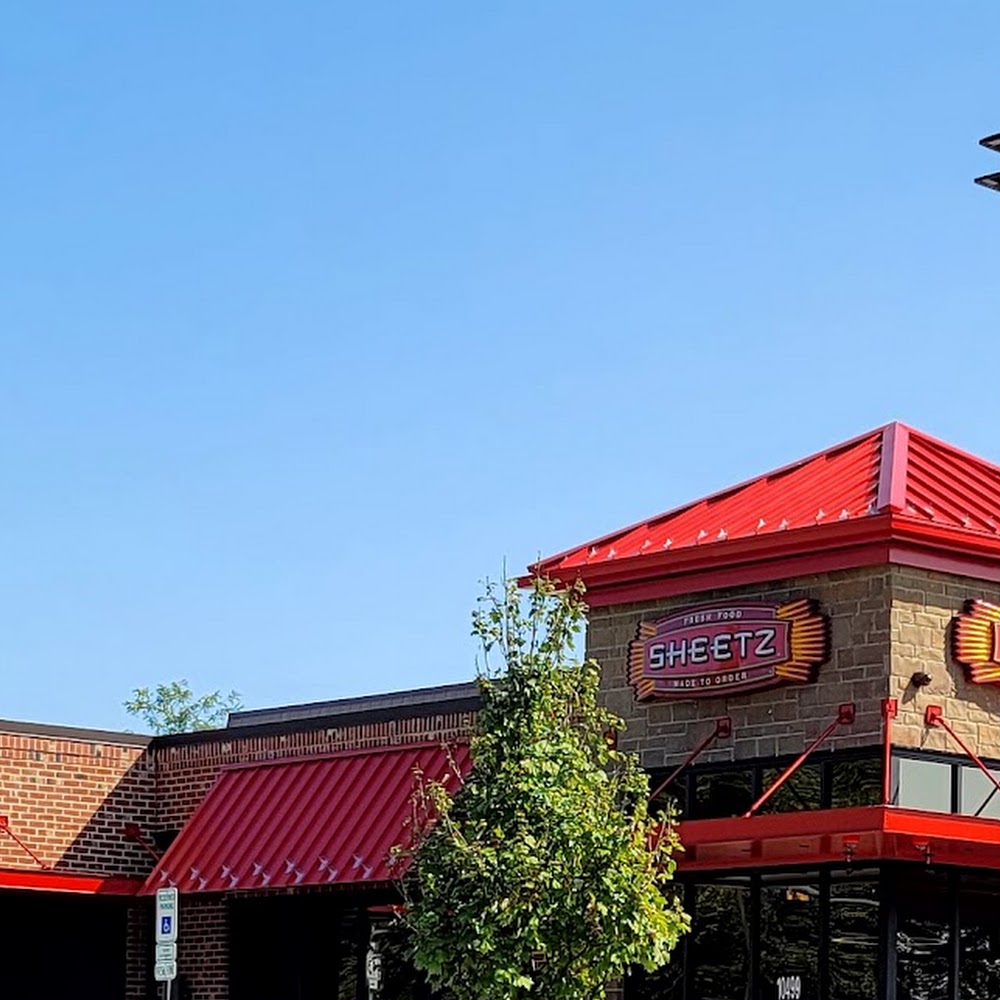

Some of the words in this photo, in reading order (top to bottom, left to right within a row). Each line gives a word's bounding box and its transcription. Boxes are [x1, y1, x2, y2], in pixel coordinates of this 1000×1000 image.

[684, 613, 712, 626] FRESH
[718, 610, 743, 620] FOOD
[649, 628, 776, 670] SHEETZ
[673, 679, 697, 688] MADE
[700, 677, 711, 686] TO
[714, 671, 748, 685] ORDER
